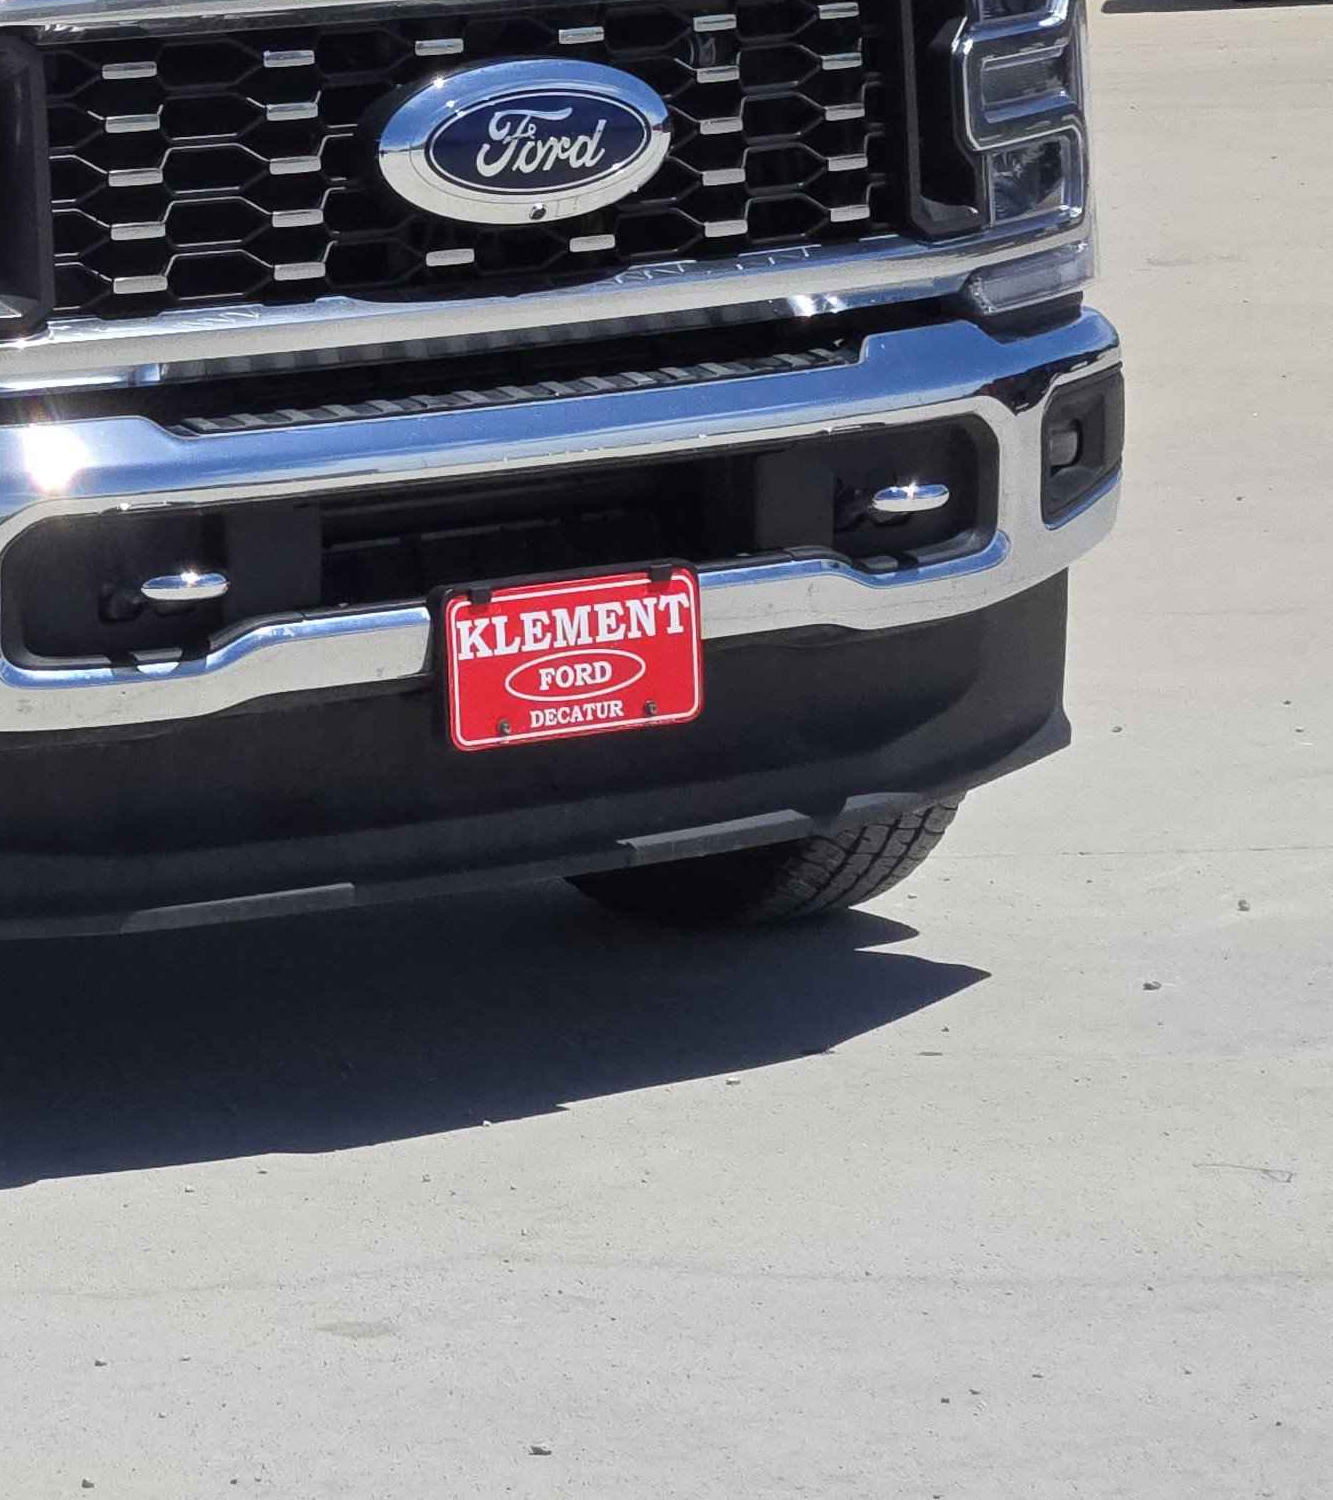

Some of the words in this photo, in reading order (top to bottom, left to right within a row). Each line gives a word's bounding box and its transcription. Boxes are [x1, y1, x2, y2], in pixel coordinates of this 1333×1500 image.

[476, 106, 607, 177] Ford
[456, 593, 690, 661] KLEMENT
[538, 661, 613, 691] FORD
[530, 700, 624, 728] DECATUR
